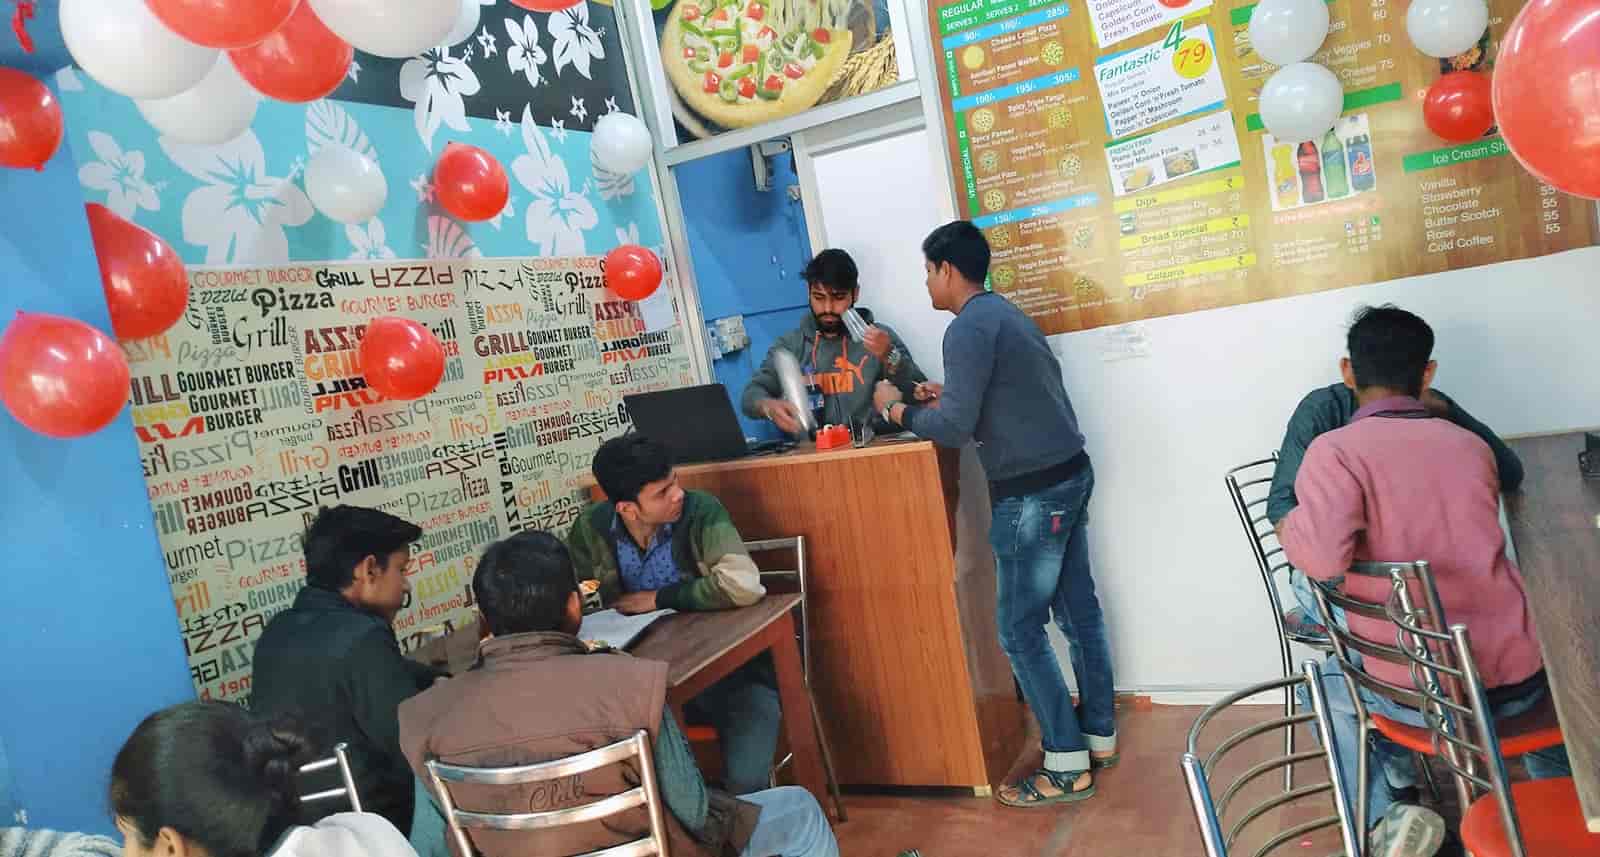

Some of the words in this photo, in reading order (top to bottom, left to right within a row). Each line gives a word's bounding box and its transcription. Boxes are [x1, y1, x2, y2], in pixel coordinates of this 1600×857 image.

[942, 2, 984, 18] REGULAR
[1101, 13, 1132, 31] Golden
[1134, 3, 1156, 16] Corn
[1104, 23, 1129, 40] Fresh
[1132, 12, 1163, 29] Tomato
[1100, 47, 1160, 81] Fantastic
[1163, 19, 1186, 51] 4
[1376, 33, 1392, 45] 70
[1178, 42, 1206, 70] 79
[1378, 58, 1394, 70] 75
[1432, 153, 1449, 166] Ice
[1451, 146, 1488, 160] Cream
[1420, 177, 1456, 191] Vanilla
[1423, 199, 1479, 215] Chocolate
[1425, 214, 1458, 229] Butter
[1460, 206, 1501, 222] Scotch
[1426, 228, 1456, 241] Rose
[1428, 239, 1454, 252] Cold
[1457, 234, 1494, 248] Coffee
[370, 265, 454, 288] PIZZA
[462, 263, 526, 295] PIZZA
[251, 287, 335, 318] Pizza
[555, 293, 586, 315] Grill
[232, 315, 289, 353] Grill
[473, 329, 530, 357] GRILL
[526, 328, 563, 346] GOURMET
[563, 325, 591, 341] BURGER
[533, 344, 572, 361] GOURMET
[176, 366, 242, 393] GOURMET
[245, 360, 296, 384] BURGER
[483, 362, 544, 386] PIZZA
[543, 358, 575, 375] BURGER
[189, 388, 258, 414] GOURMET
[205, 407, 263, 433] BURGER
[506, 421, 535, 449] Grill
[510, 449, 558, 474] Gourmet
[337, 459, 381, 494] Grill
[406, 488, 464, 517] Pizza
[422, 526, 471, 550] GOURMET
[166, 536, 224, 570] urmet
[225, 532, 304, 570] Pizza
[175, 581, 211, 618] rill
[184, 613, 265, 656] IZZA
